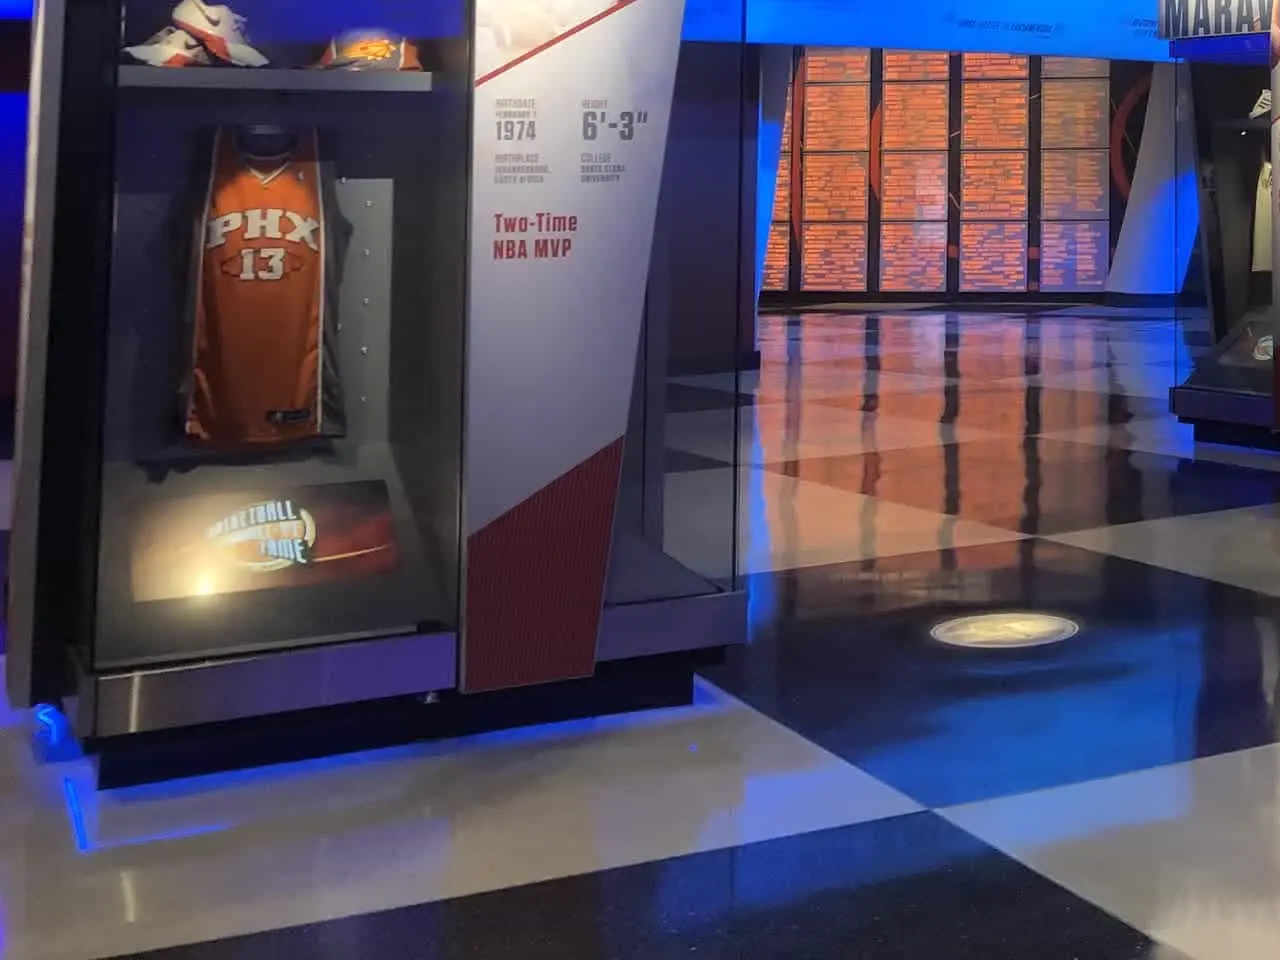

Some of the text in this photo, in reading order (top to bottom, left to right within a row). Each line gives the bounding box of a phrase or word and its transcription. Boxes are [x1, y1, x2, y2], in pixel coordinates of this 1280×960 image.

[496, 121, 537, 141] 1974
[582, 111, 648, 141] 6'-3"
[206, 208, 320, 250] PHX
[494, 212, 578, 233] Two-Time
[493, 238, 572, 260] NBA MVP
[239, 247, 286, 281] 13
